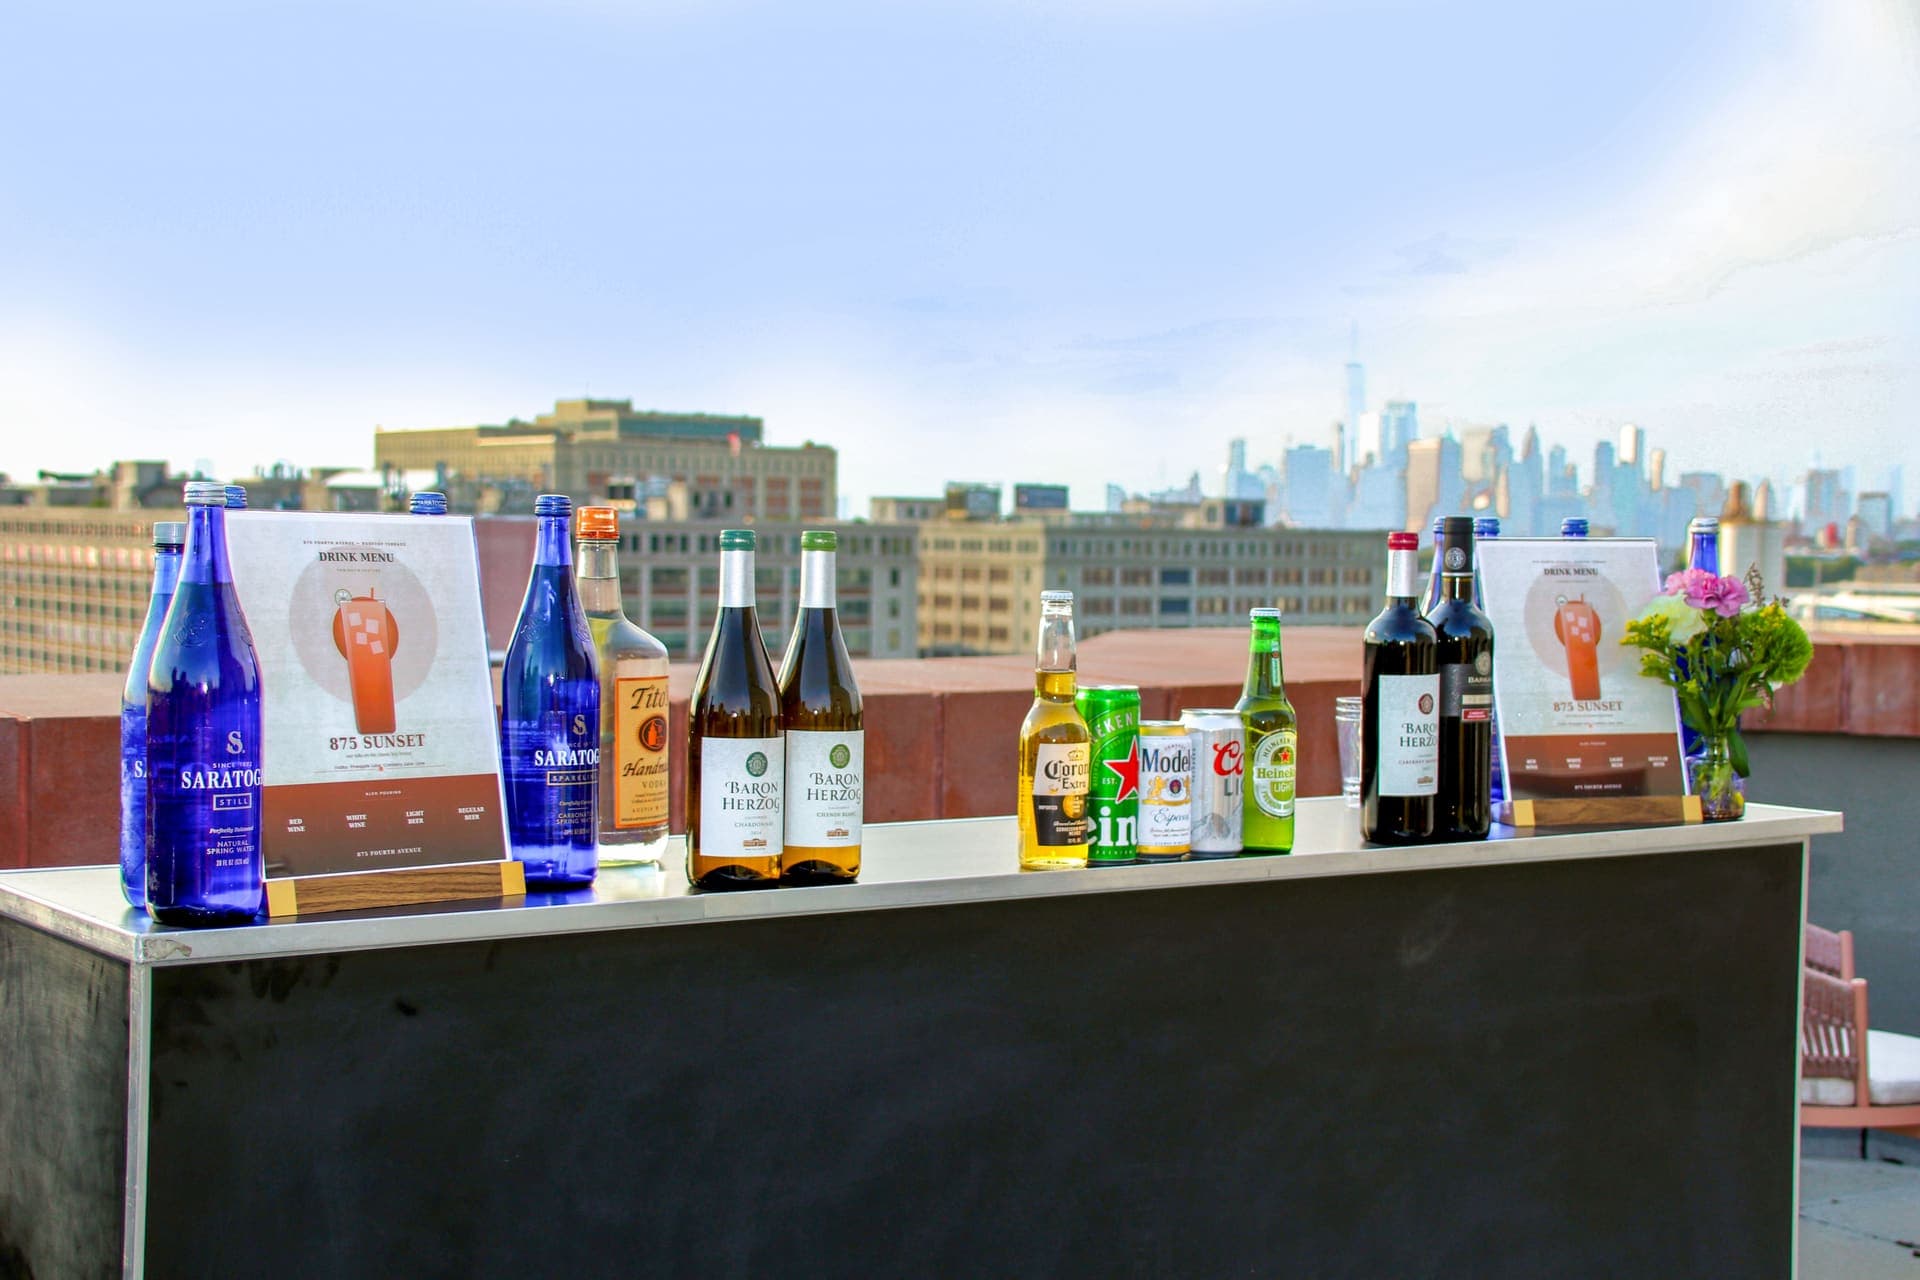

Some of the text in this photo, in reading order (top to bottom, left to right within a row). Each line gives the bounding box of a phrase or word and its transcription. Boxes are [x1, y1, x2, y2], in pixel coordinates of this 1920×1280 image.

[318, 551, 395, 563] DRINK MENU
[1543, 568, 1599, 576] DRINK MENU
[631, 685, 668, 710] Tito
[1553, 701, 1623, 712] 875 SUNSET
[329, 733, 426, 751] 875 SUNSET
[181, 768, 264, 789] SARATOG
[809, 772, 860, 790] BARON
[1061, 777, 1087, 790] Extra
[725, 780, 779, 798] BARON
[218, 798, 249, 806] STILL
[807, 788, 861, 805] HERZOG
[457, 806, 485, 814] REGULAR
[722, 797, 780, 813] HERZOG
[405, 810, 424, 818] LIGHT
[287, 825, 306, 833] WINE
[348, 821, 367, 829] WINE
[217, 840, 249, 848] NATURAL
[206, 847, 234, 855] SPRING
[370, 848, 397, 856] FOURTH
